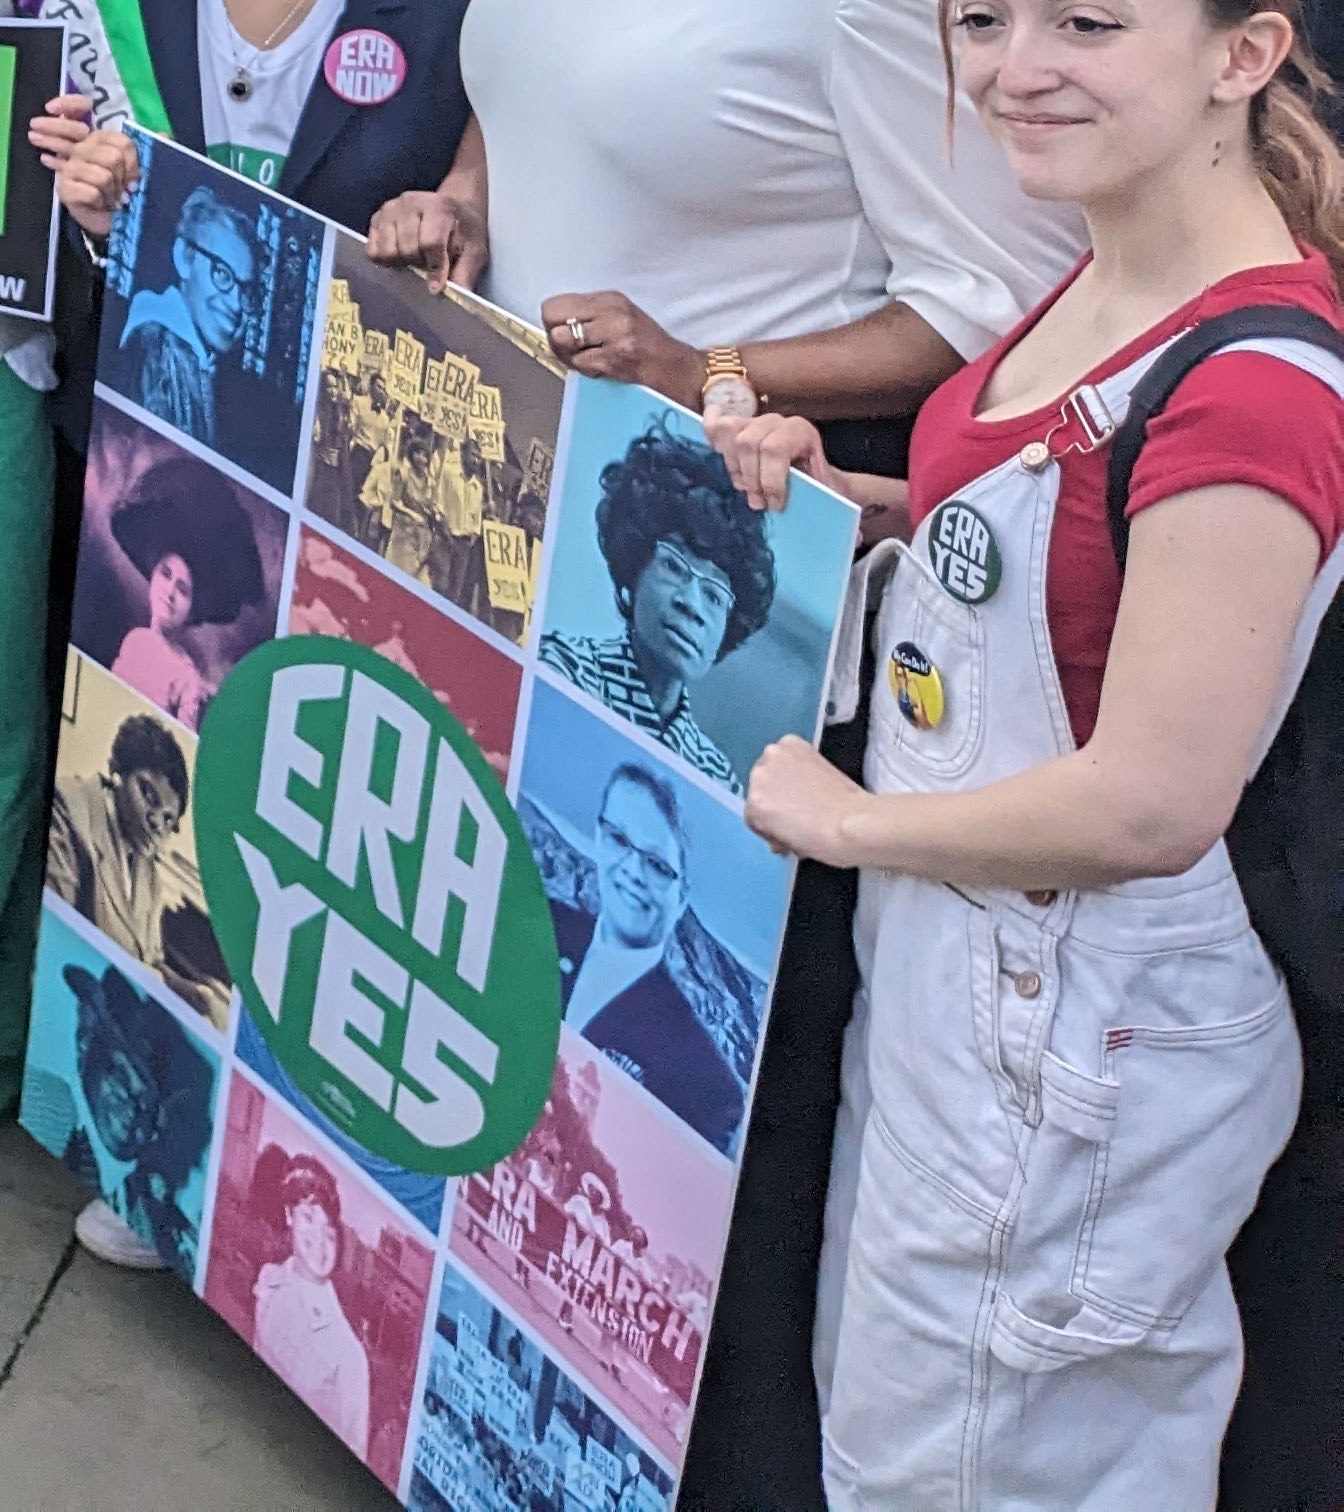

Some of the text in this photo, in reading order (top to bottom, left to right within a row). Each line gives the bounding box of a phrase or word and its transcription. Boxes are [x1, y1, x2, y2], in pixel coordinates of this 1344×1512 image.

[340, 35, 394, 69] ERA
[335, 67, 397, 100] NOW
[396, 337, 421, 372] ERA
[443, 361, 477, 404] ERA
[486, 528, 526, 570] ERA
[938, 506, 990, 566] ERA
[932, 539, 988, 600] YES
[255, 663, 509, 993] ERA
[232, 830, 500, 1149] YES
[545, 1250, 655, 1365] EXTENSION
[562, 1219, 695, 1361] MARCH
